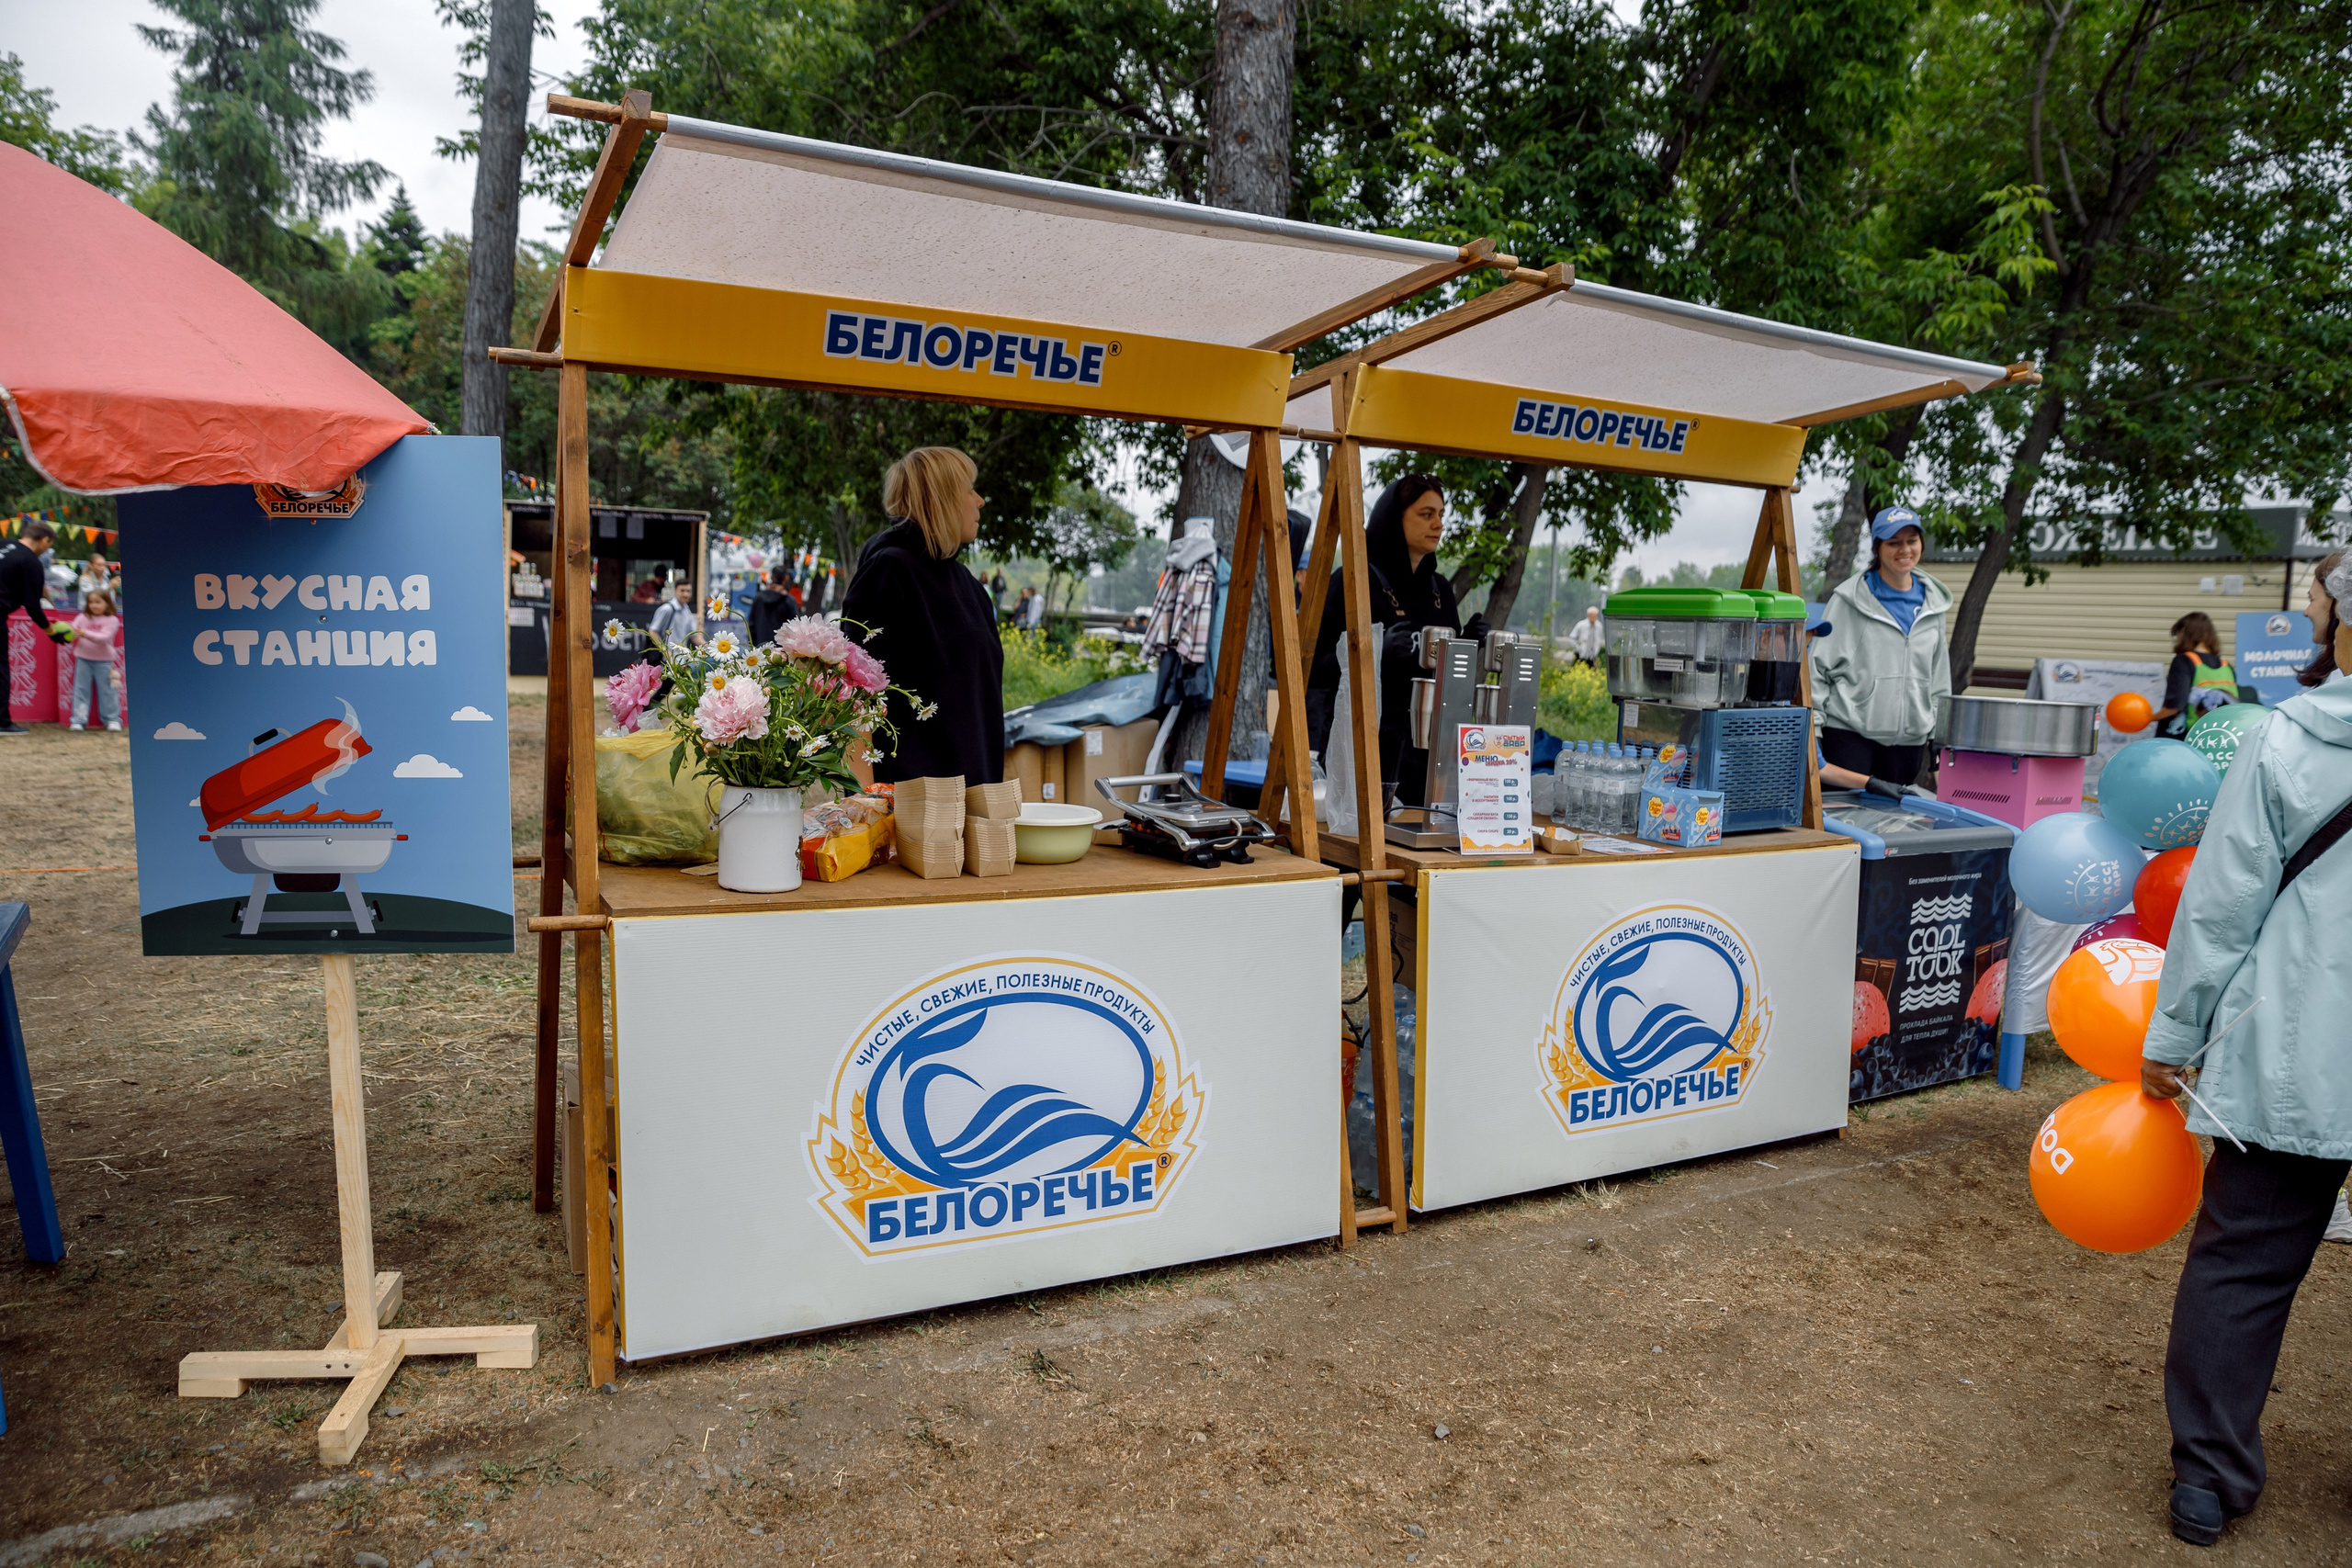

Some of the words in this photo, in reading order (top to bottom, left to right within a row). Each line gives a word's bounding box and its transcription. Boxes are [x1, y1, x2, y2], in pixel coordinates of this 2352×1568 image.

[270, 502, 349, 513] БЕЛОРЕЧЬЕ
[194, 573, 431, 612] ВКУСНАЯ
[193, 629, 437, 666] СТАНЦИЯ
[1908, 877, 1918, 886] Без
[1569, 942, 1611, 988] ЧИСТЫЕ,
[1610, 919, 1655, 947] СВЕЖИЕ,
[1656, 917, 1706, 933] ПОЛЕЗНЫЕ
[1706, 924, 1747, 966] ПРОДУКТЫ
[1907, 923, 1966, 955] COOL
[855, 1010, 920, 1067] ЧИСТЫЕ,
[920, 977, 993, 1012] СВЕЖИЕ,
[996, 973, 1082, 992] ПОЛЕЗНЫЕ
[1083, 980, 1156, 1035] ПРОДУКТЫ
[1928, 1014, 1953, 1025] БАЙКАЛА
[1913, 1032, 1930, 1040] ТЕПЛА
